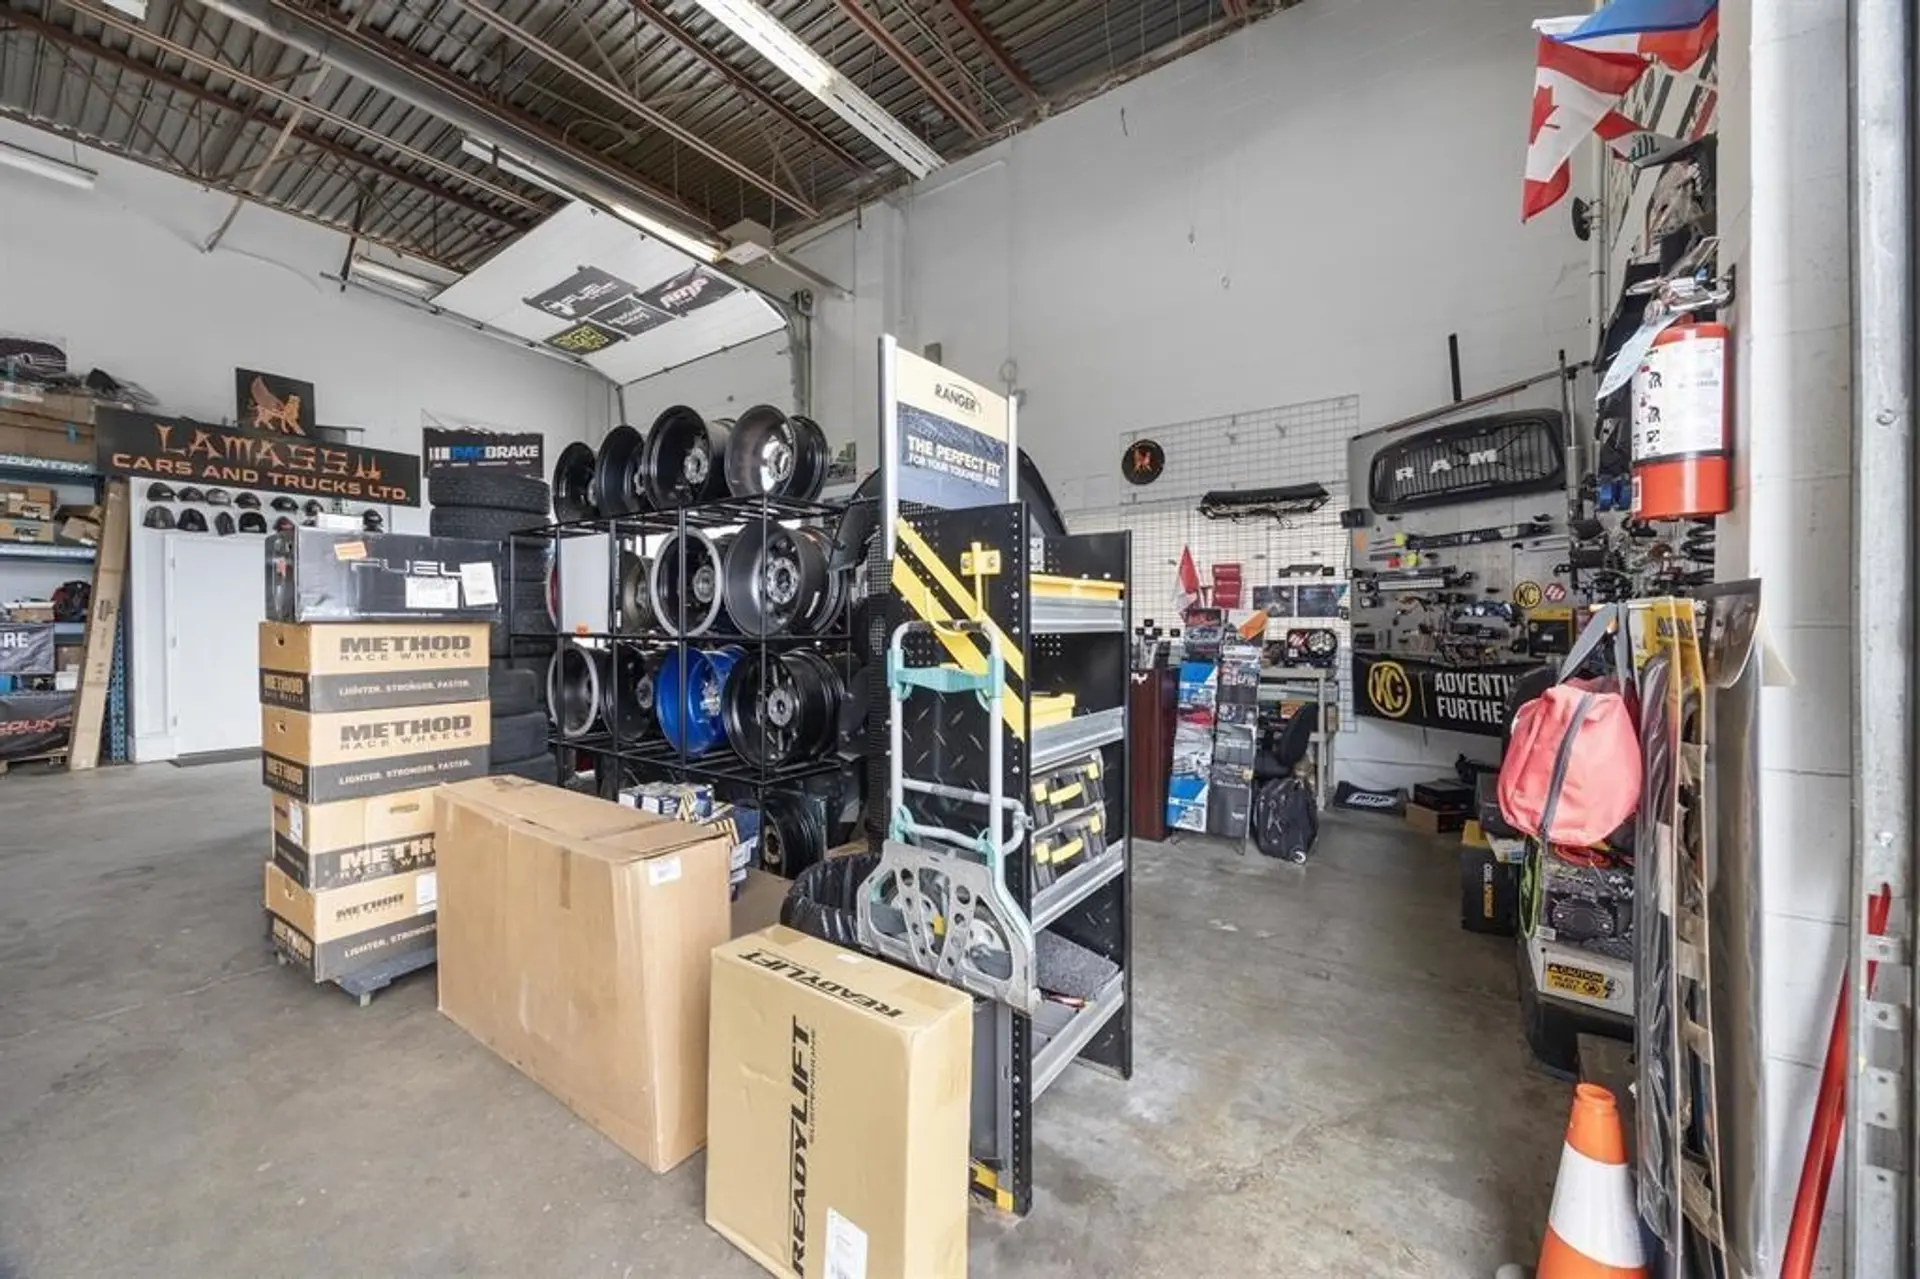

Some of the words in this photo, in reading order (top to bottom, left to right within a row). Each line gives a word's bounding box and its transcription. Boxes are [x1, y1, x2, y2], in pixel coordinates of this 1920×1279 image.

[934, 383, 976, 411] RANGER
[907, 435, 934, 457] THE
[936, 443, 984, 473] PERFECT
[986, 460, 1001, 479] FIT
[909, 453, 926, 466] FOR
[928, 458, 949, 472] YOUR
[1395, 449, 1497, 481] RAM
[112, 453, 193, 475] CARS
[203, 465, 260, 483] AND
[267, 472, 361, 496] TRUCKS
[368, 484, 411, 501] LTD.
[340, 635, 471, 654] METHOD
[340, 653, 388, 661] RACE
[401, 651, 471, 660] WHEELS
[1373, 666, 1404, 712] KC
[341, 715, 471, 741] METHOD
[341, 738, 389, 750] RACE
[402, 730, 471, 744] WHEELS
[340, 837, 436, 871] METH
[738, 951, 905, 1020] READYLIFT
[790, 1014, 809, 1278] READYLIFT
